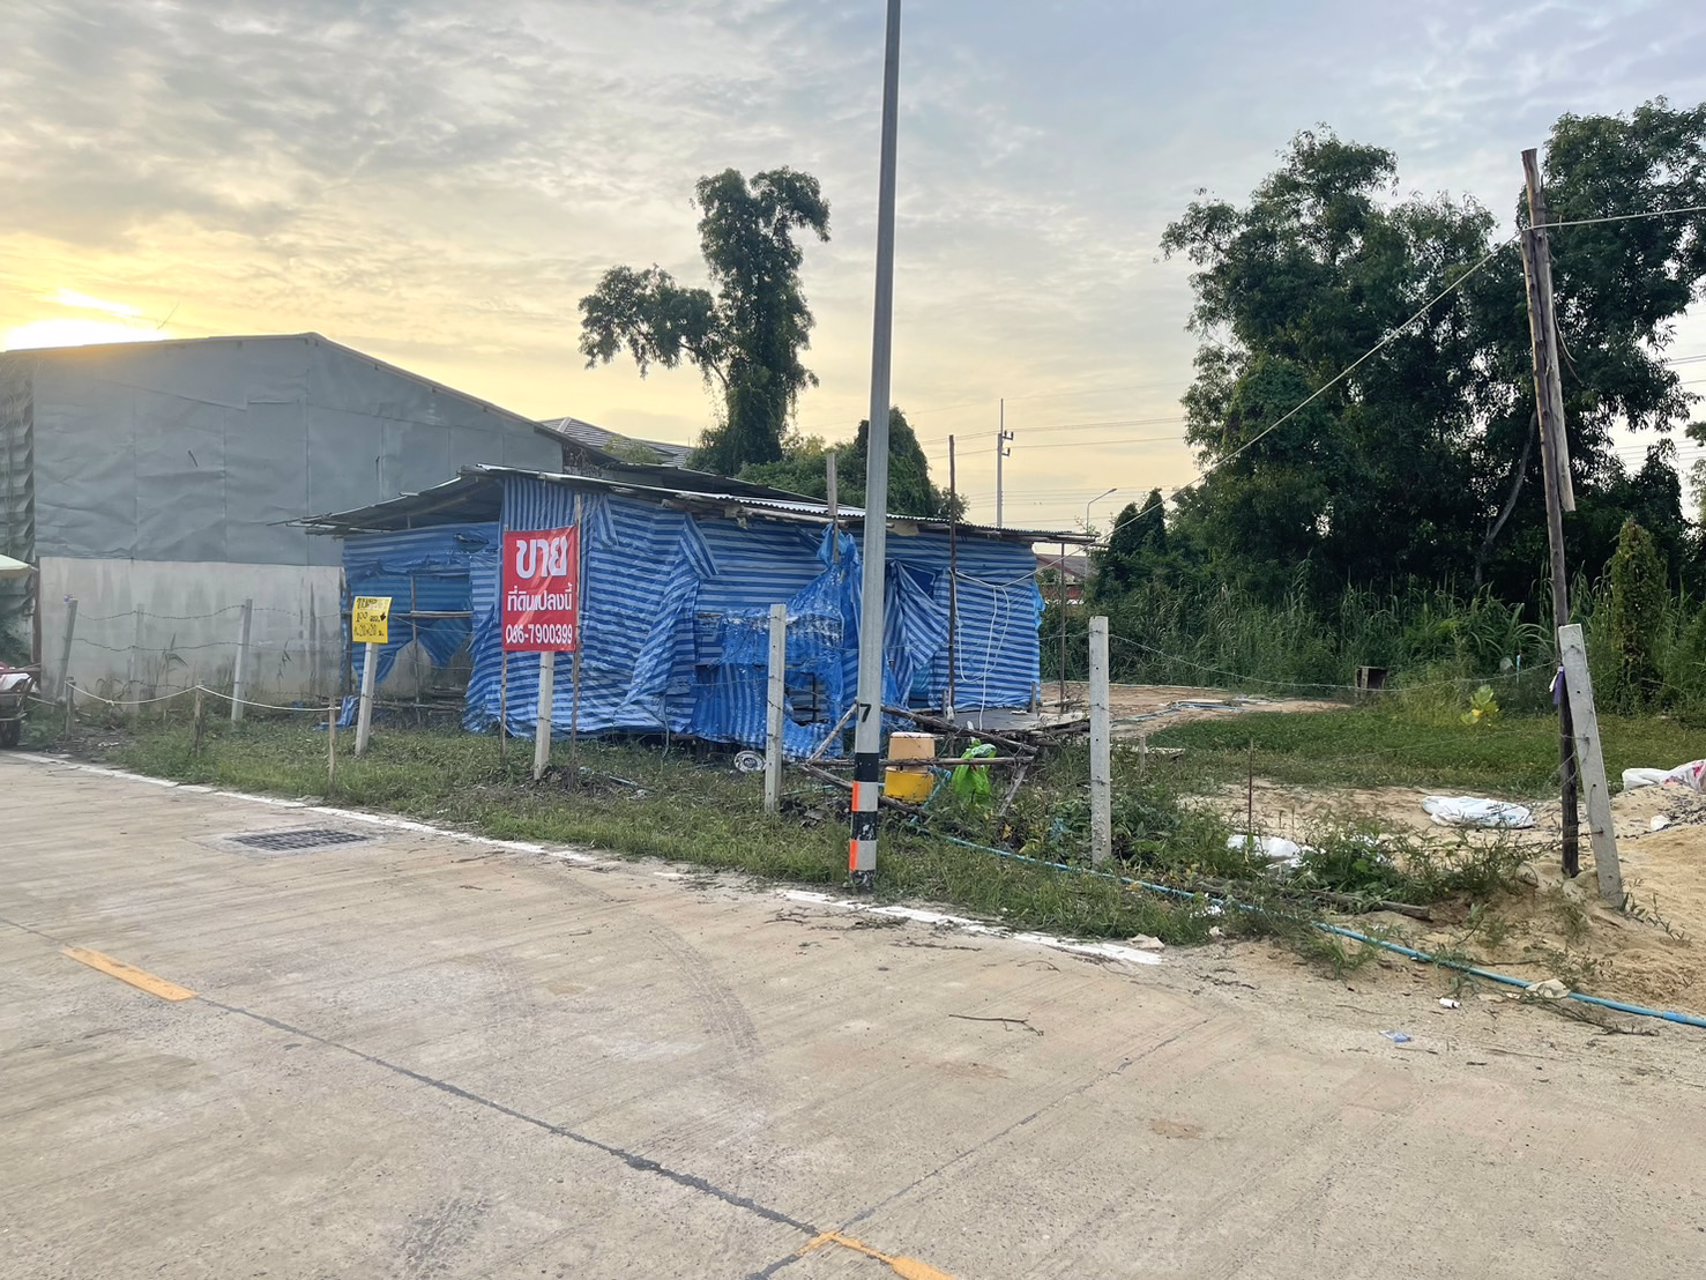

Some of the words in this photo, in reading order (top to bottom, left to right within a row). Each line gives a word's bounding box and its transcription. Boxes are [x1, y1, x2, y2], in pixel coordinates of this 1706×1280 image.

[516, 535, 568, 579] ขาย
[507, 583, 573, 611] ที่ดินแปลงนี้
